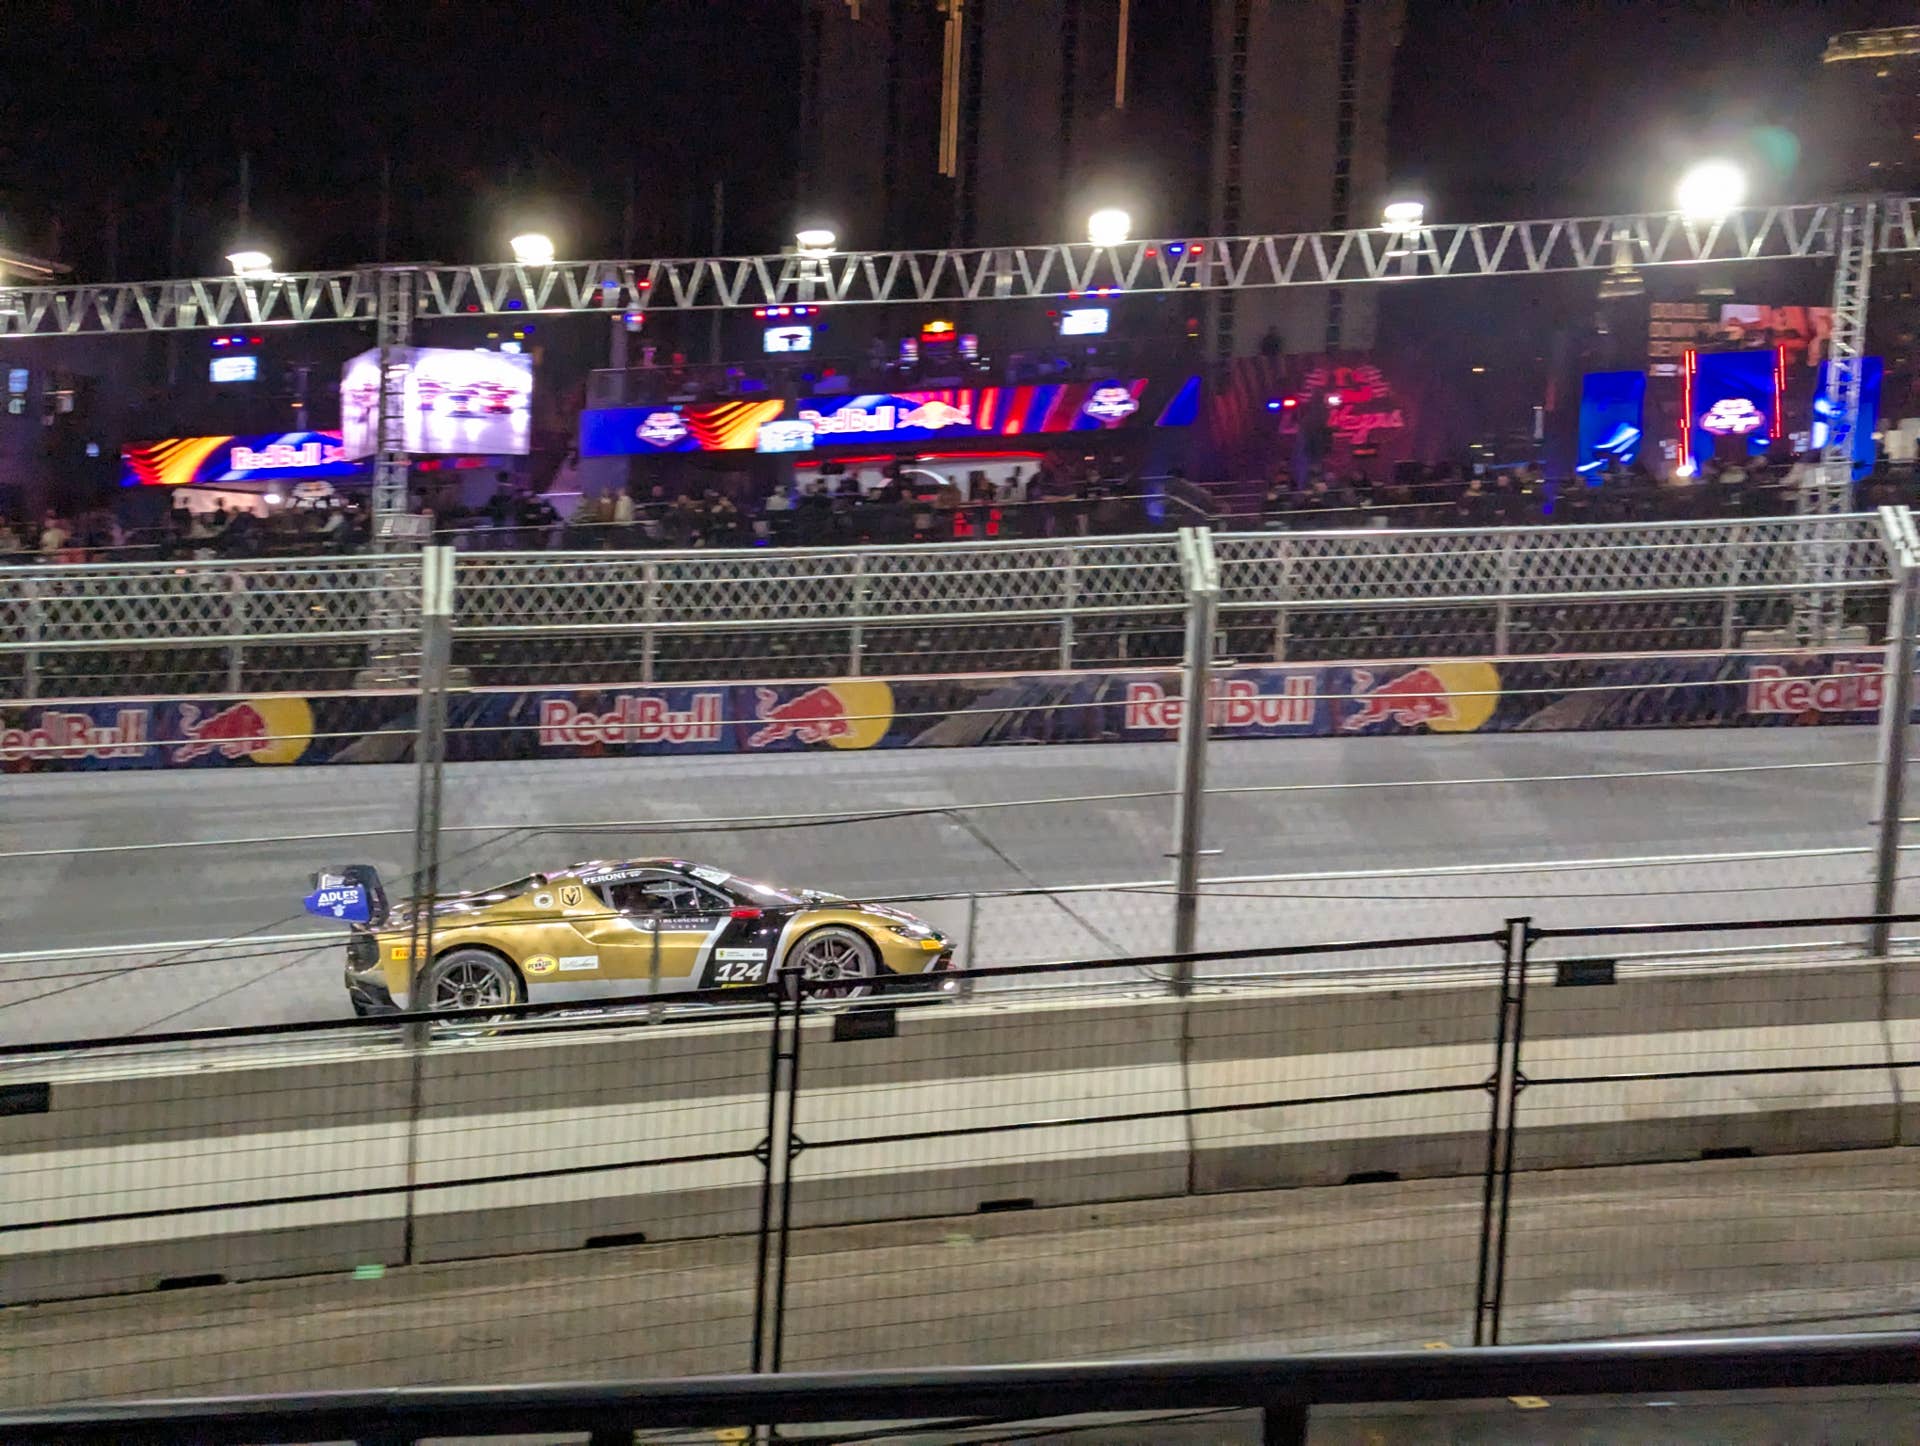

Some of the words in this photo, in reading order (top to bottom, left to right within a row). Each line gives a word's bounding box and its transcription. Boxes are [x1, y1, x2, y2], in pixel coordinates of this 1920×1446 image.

[0, 710, 60, 761] ed
[583, 872, 626, 885] PERONI
[318, 890, 359, 902] ADLER
[714, 962, 764, 982] 124
